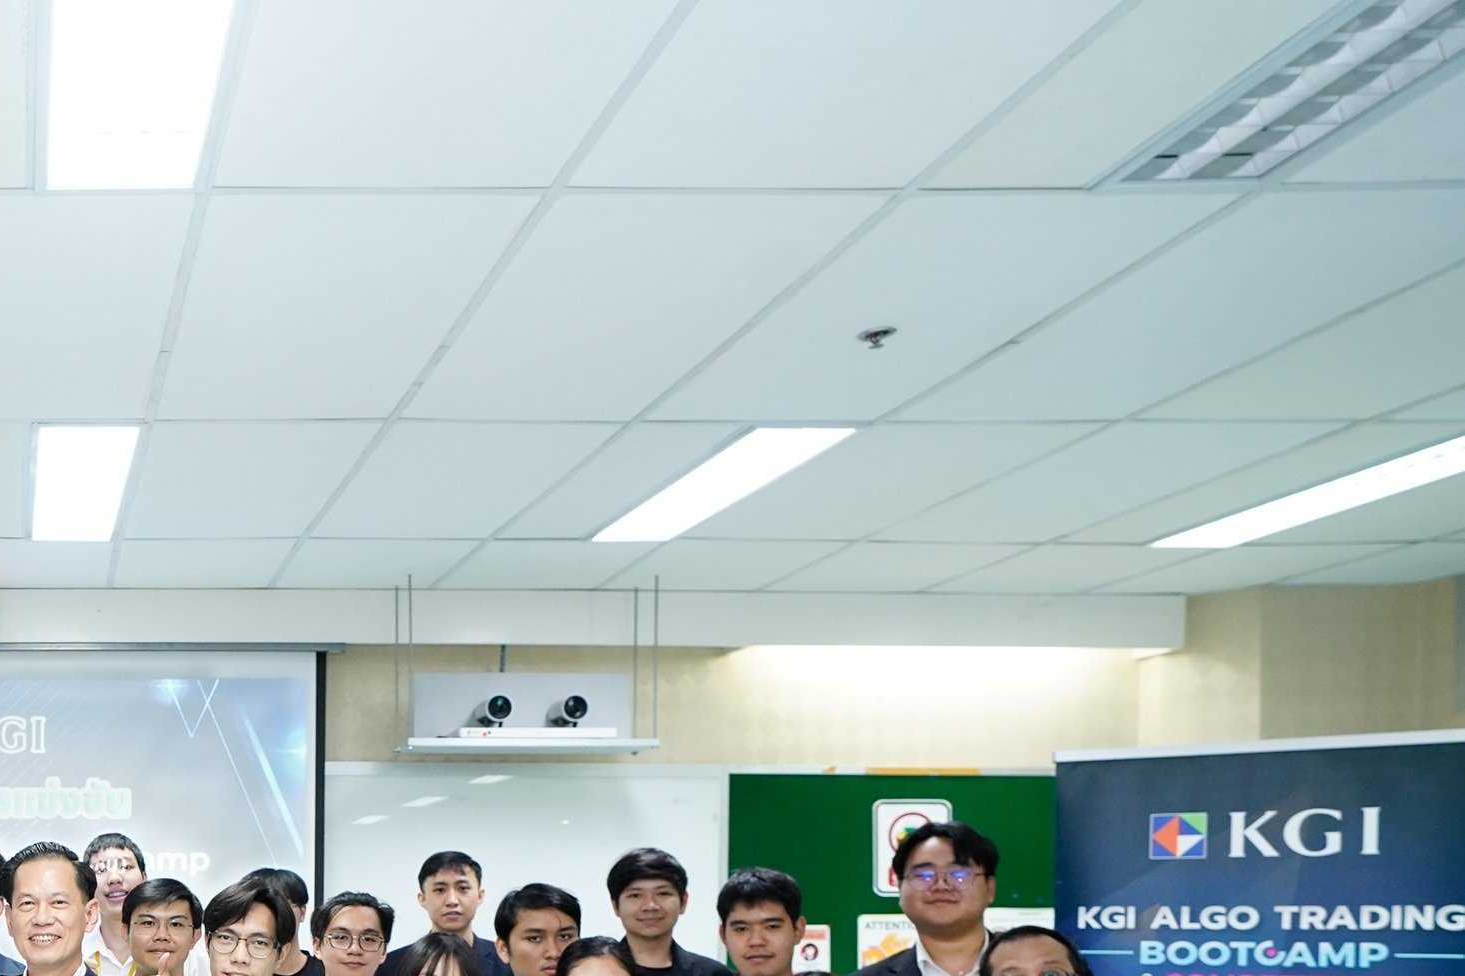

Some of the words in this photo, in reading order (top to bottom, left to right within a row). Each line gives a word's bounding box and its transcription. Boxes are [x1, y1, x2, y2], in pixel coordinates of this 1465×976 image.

[1228, 806, 1381, 858] KGI
[1077, 906, 1136, 930] KGI
[1150, 905, 1260, 931] ALGO
[1273, 904, 1465, 932] TRADING
[1139, 940, 1390, 969] BOOTCAMP
